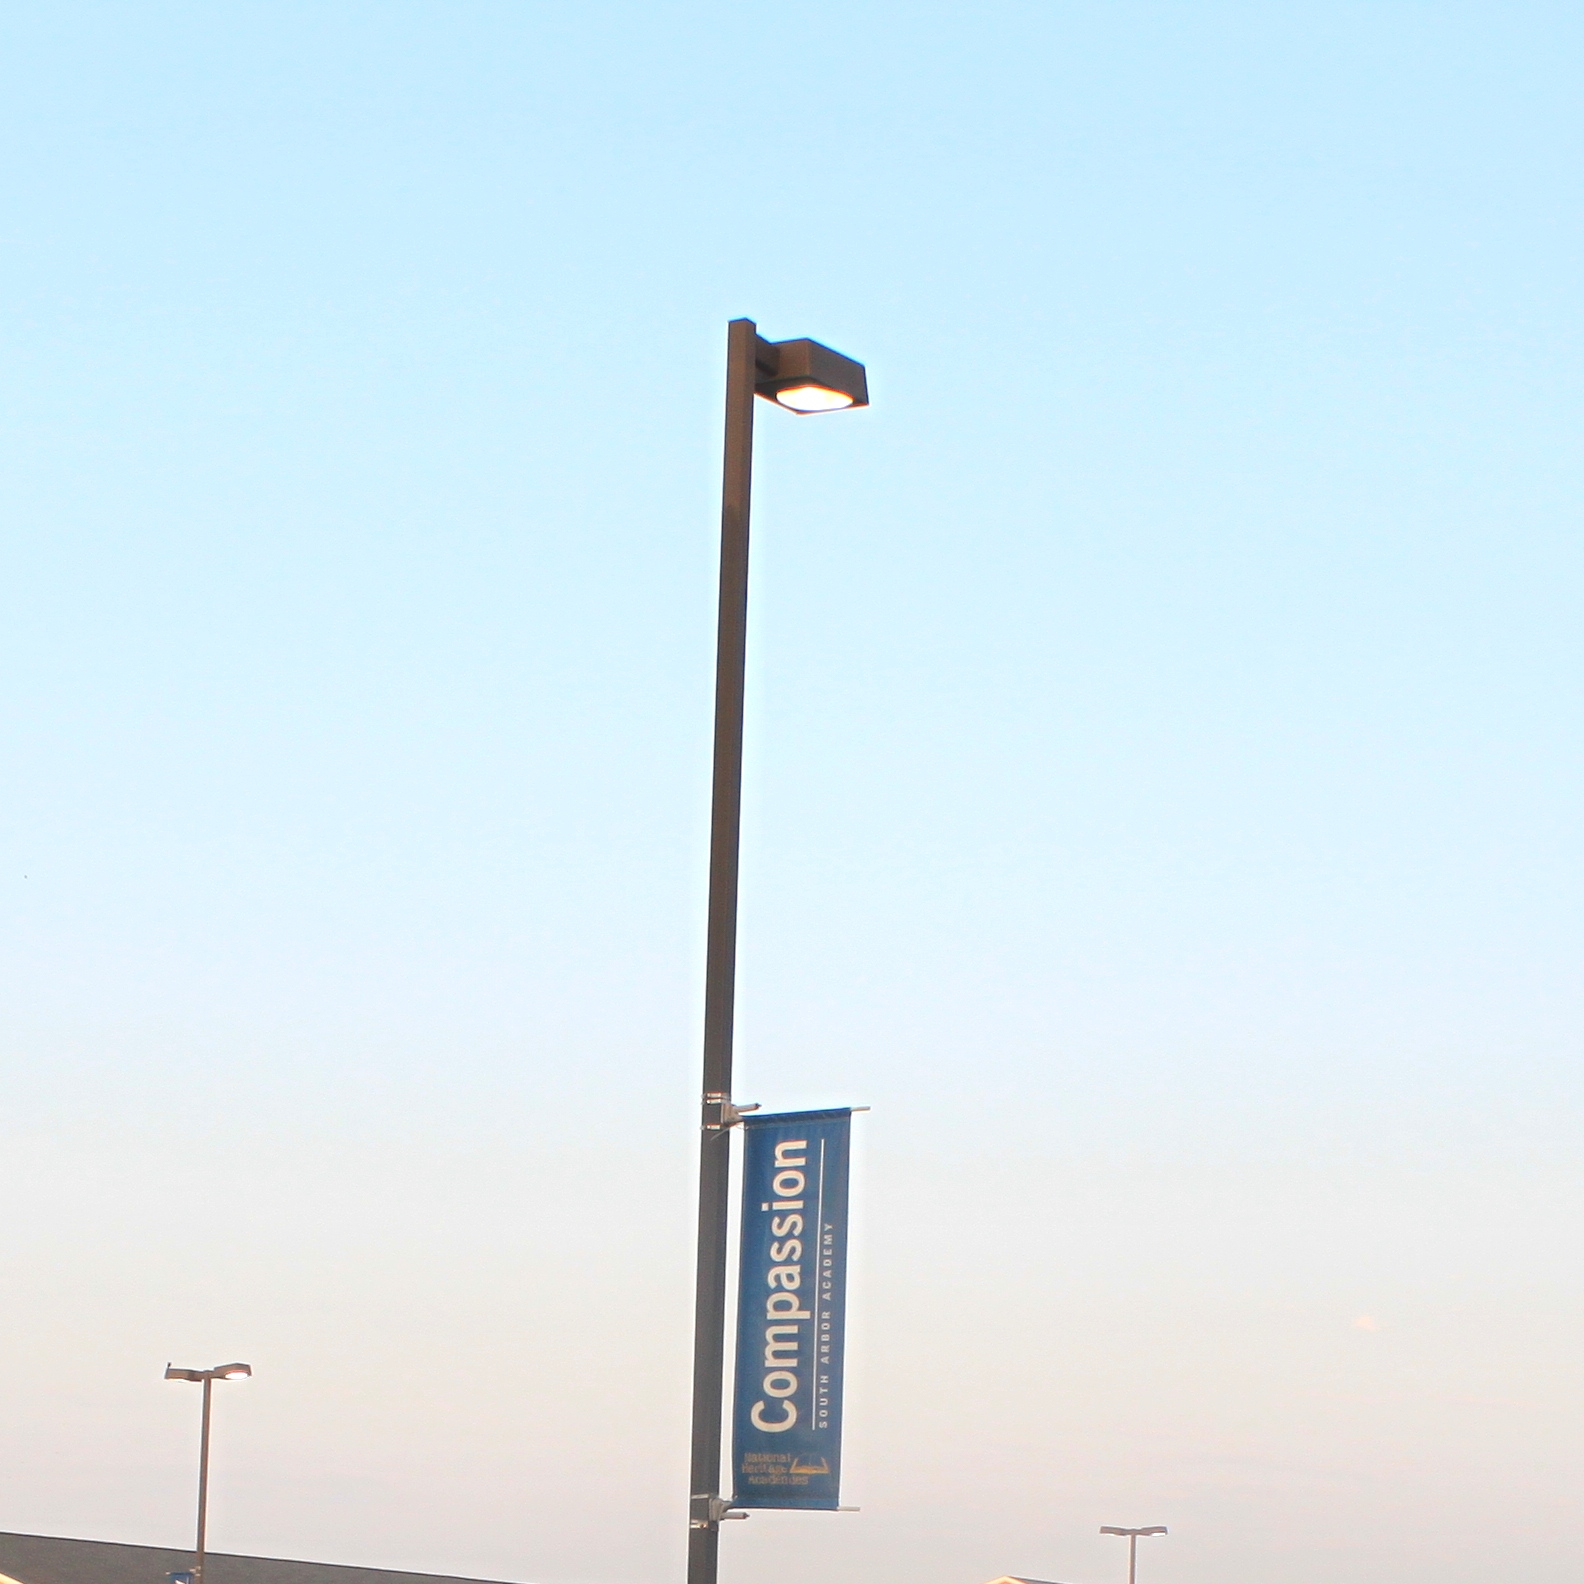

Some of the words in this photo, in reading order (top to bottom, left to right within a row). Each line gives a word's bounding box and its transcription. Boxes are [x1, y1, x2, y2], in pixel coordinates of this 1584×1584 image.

[751, 1138, 811, 1433] Compassion
[822, 1222, 834, 1301] ACADEMY
[820, 1310, 831, 1364] ARBOR
[818, 1375, 829, 1429] SOUTH
